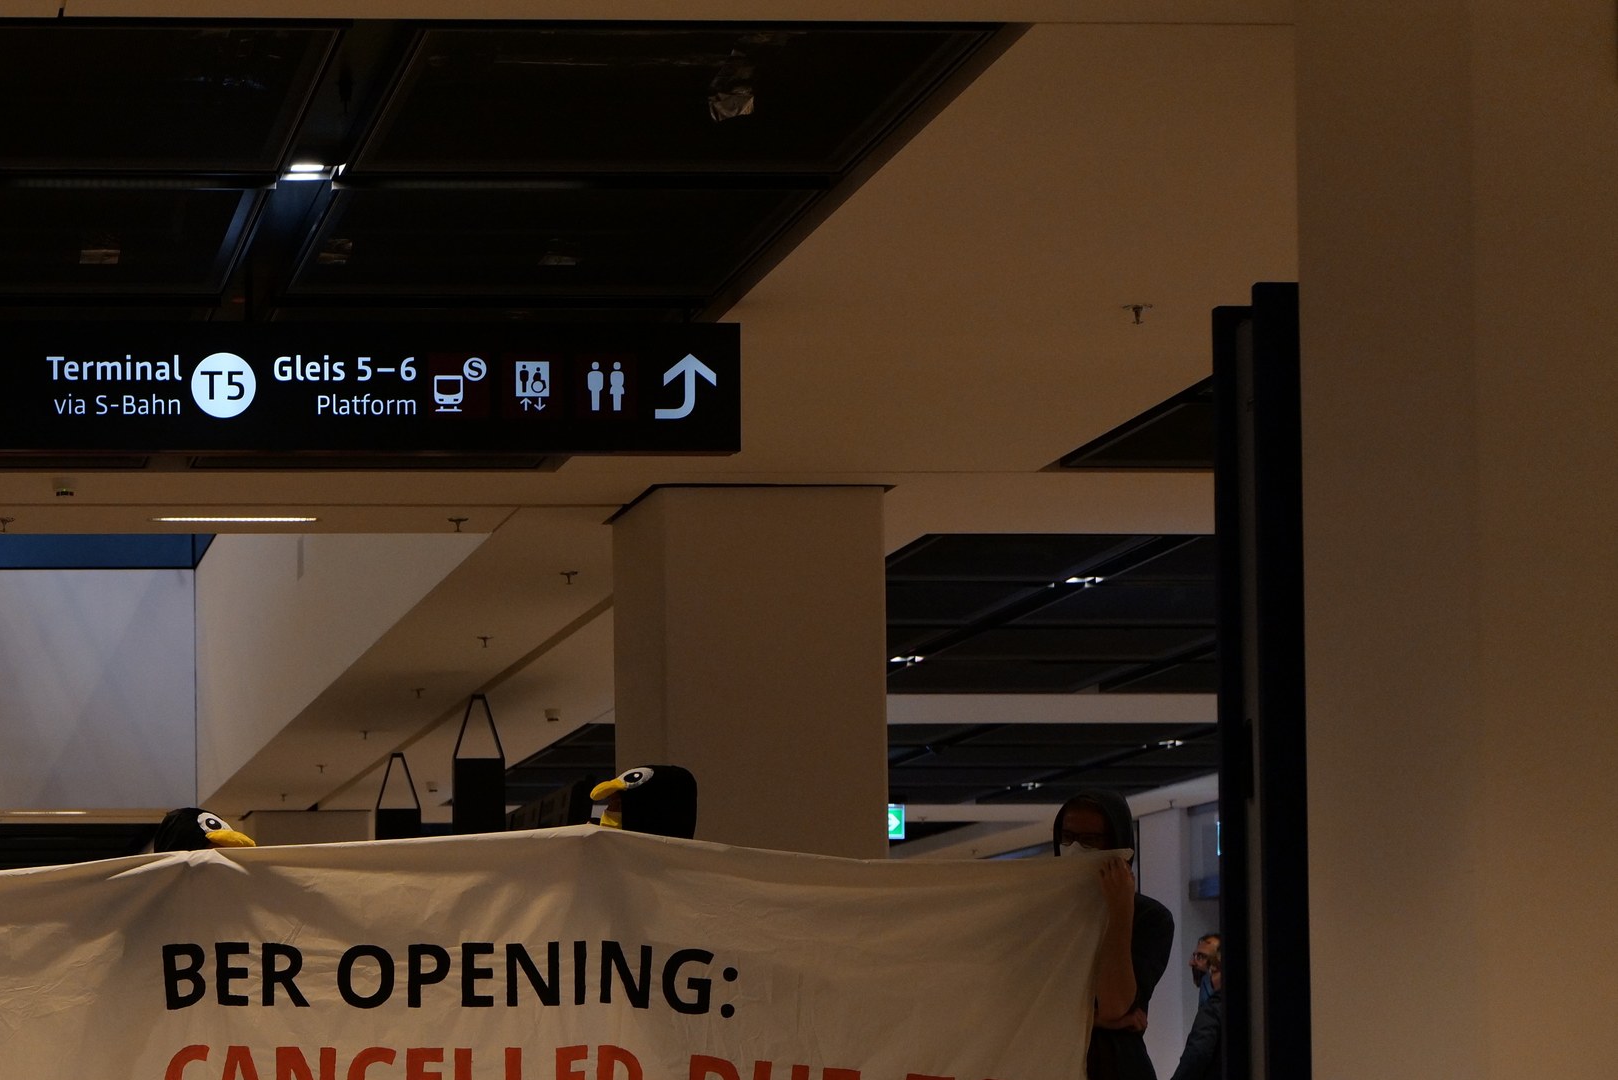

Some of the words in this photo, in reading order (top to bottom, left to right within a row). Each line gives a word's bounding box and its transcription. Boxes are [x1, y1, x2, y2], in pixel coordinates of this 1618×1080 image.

[46, 355, 183, 381] Terminal
[273, 355, 346, 382] Gleis
[199, 371, 245, 401] T5
[54, 394, 85, 415] via
[95, 393, 181, 415] S-Bahn
[317, 393, 417, 416] Platform
[163, 942, 311, 1011] BER
[338, 941, 739, 1019] OPENING:
